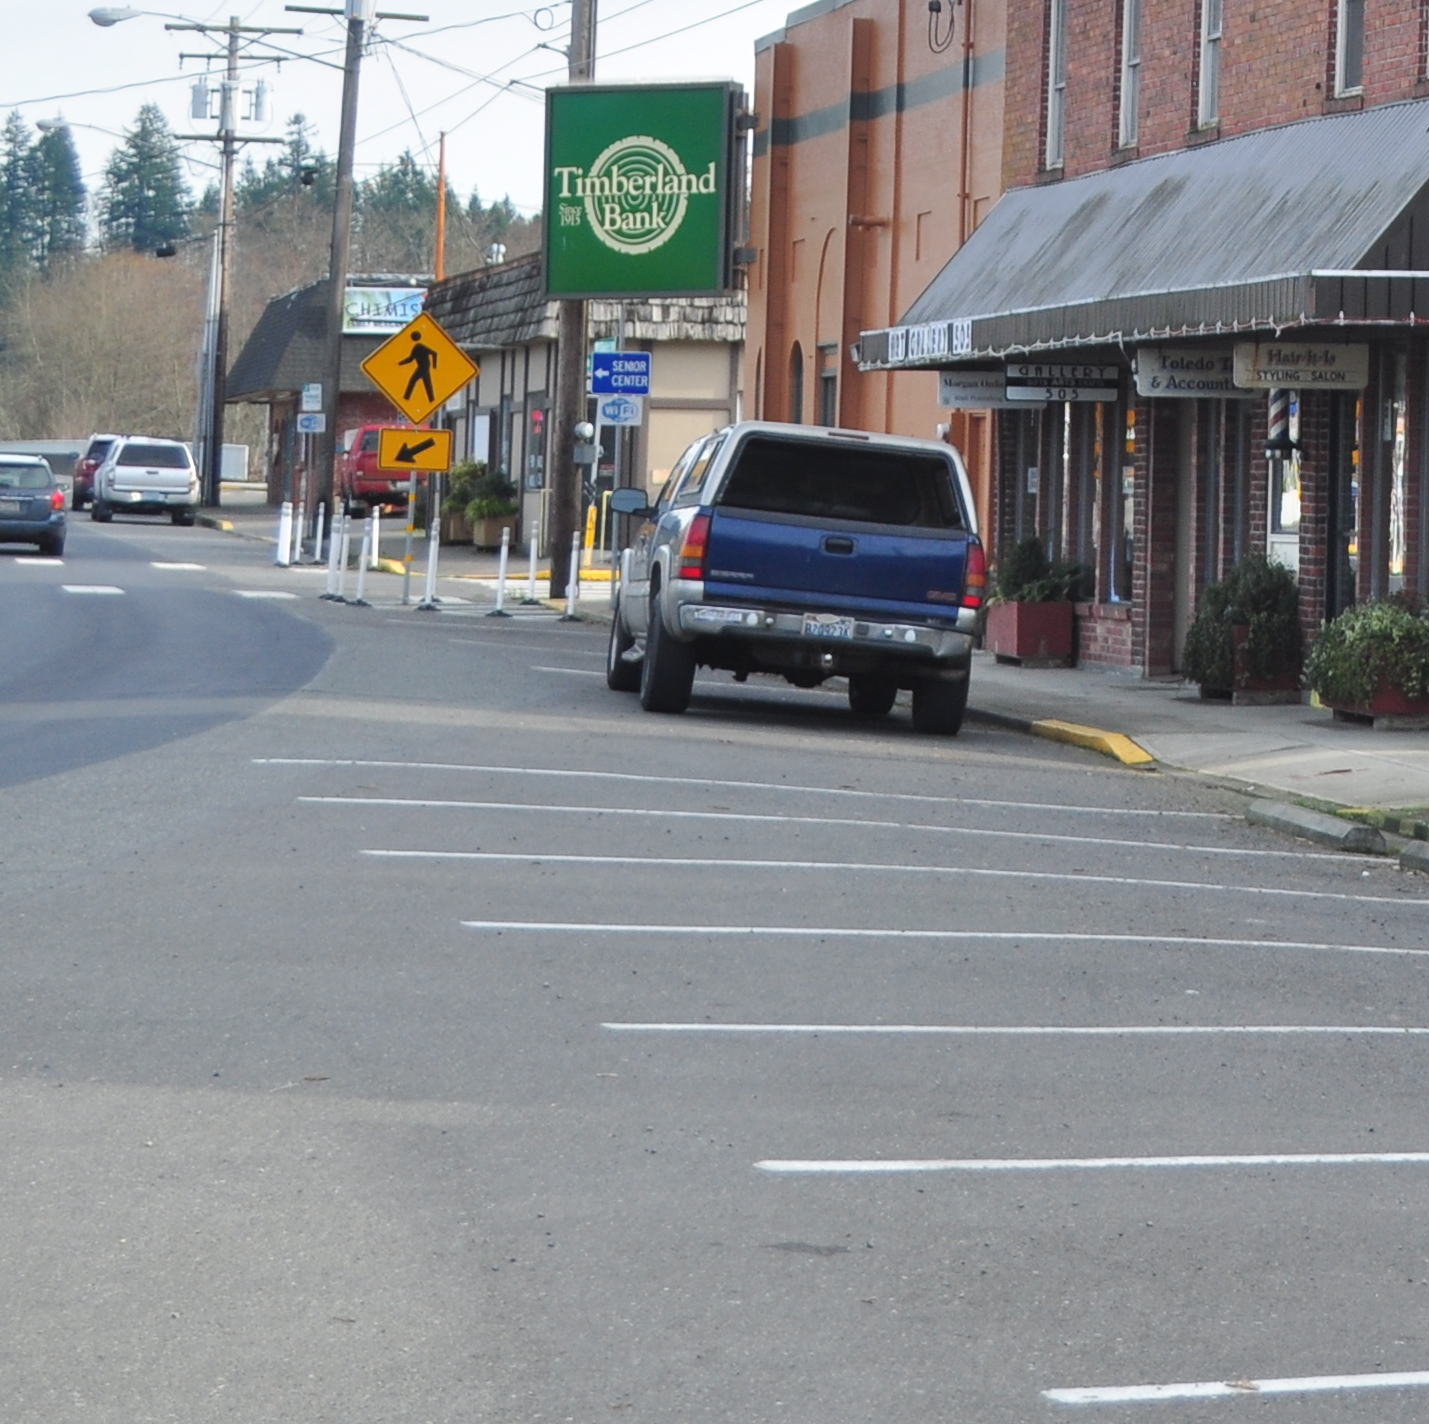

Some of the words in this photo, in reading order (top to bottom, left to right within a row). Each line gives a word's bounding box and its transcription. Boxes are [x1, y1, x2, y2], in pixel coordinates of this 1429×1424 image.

[553, 160, 717, 198] Timberland
[602, 200, 668, 231] Bank
[612, 360, 647, 373] SENIOR
[1158, 354, 1216, 371] Toledo
[1018, 365, 1106, 378] GALLERY
[1256, 370, 1301, 381] STYLING
[1310, 370, 1346, 382] SALON
[611, 374, 649, 388] CENTER
[1150, 375, 1161, 389] &
[1044, 388, 1080, 400] 505
